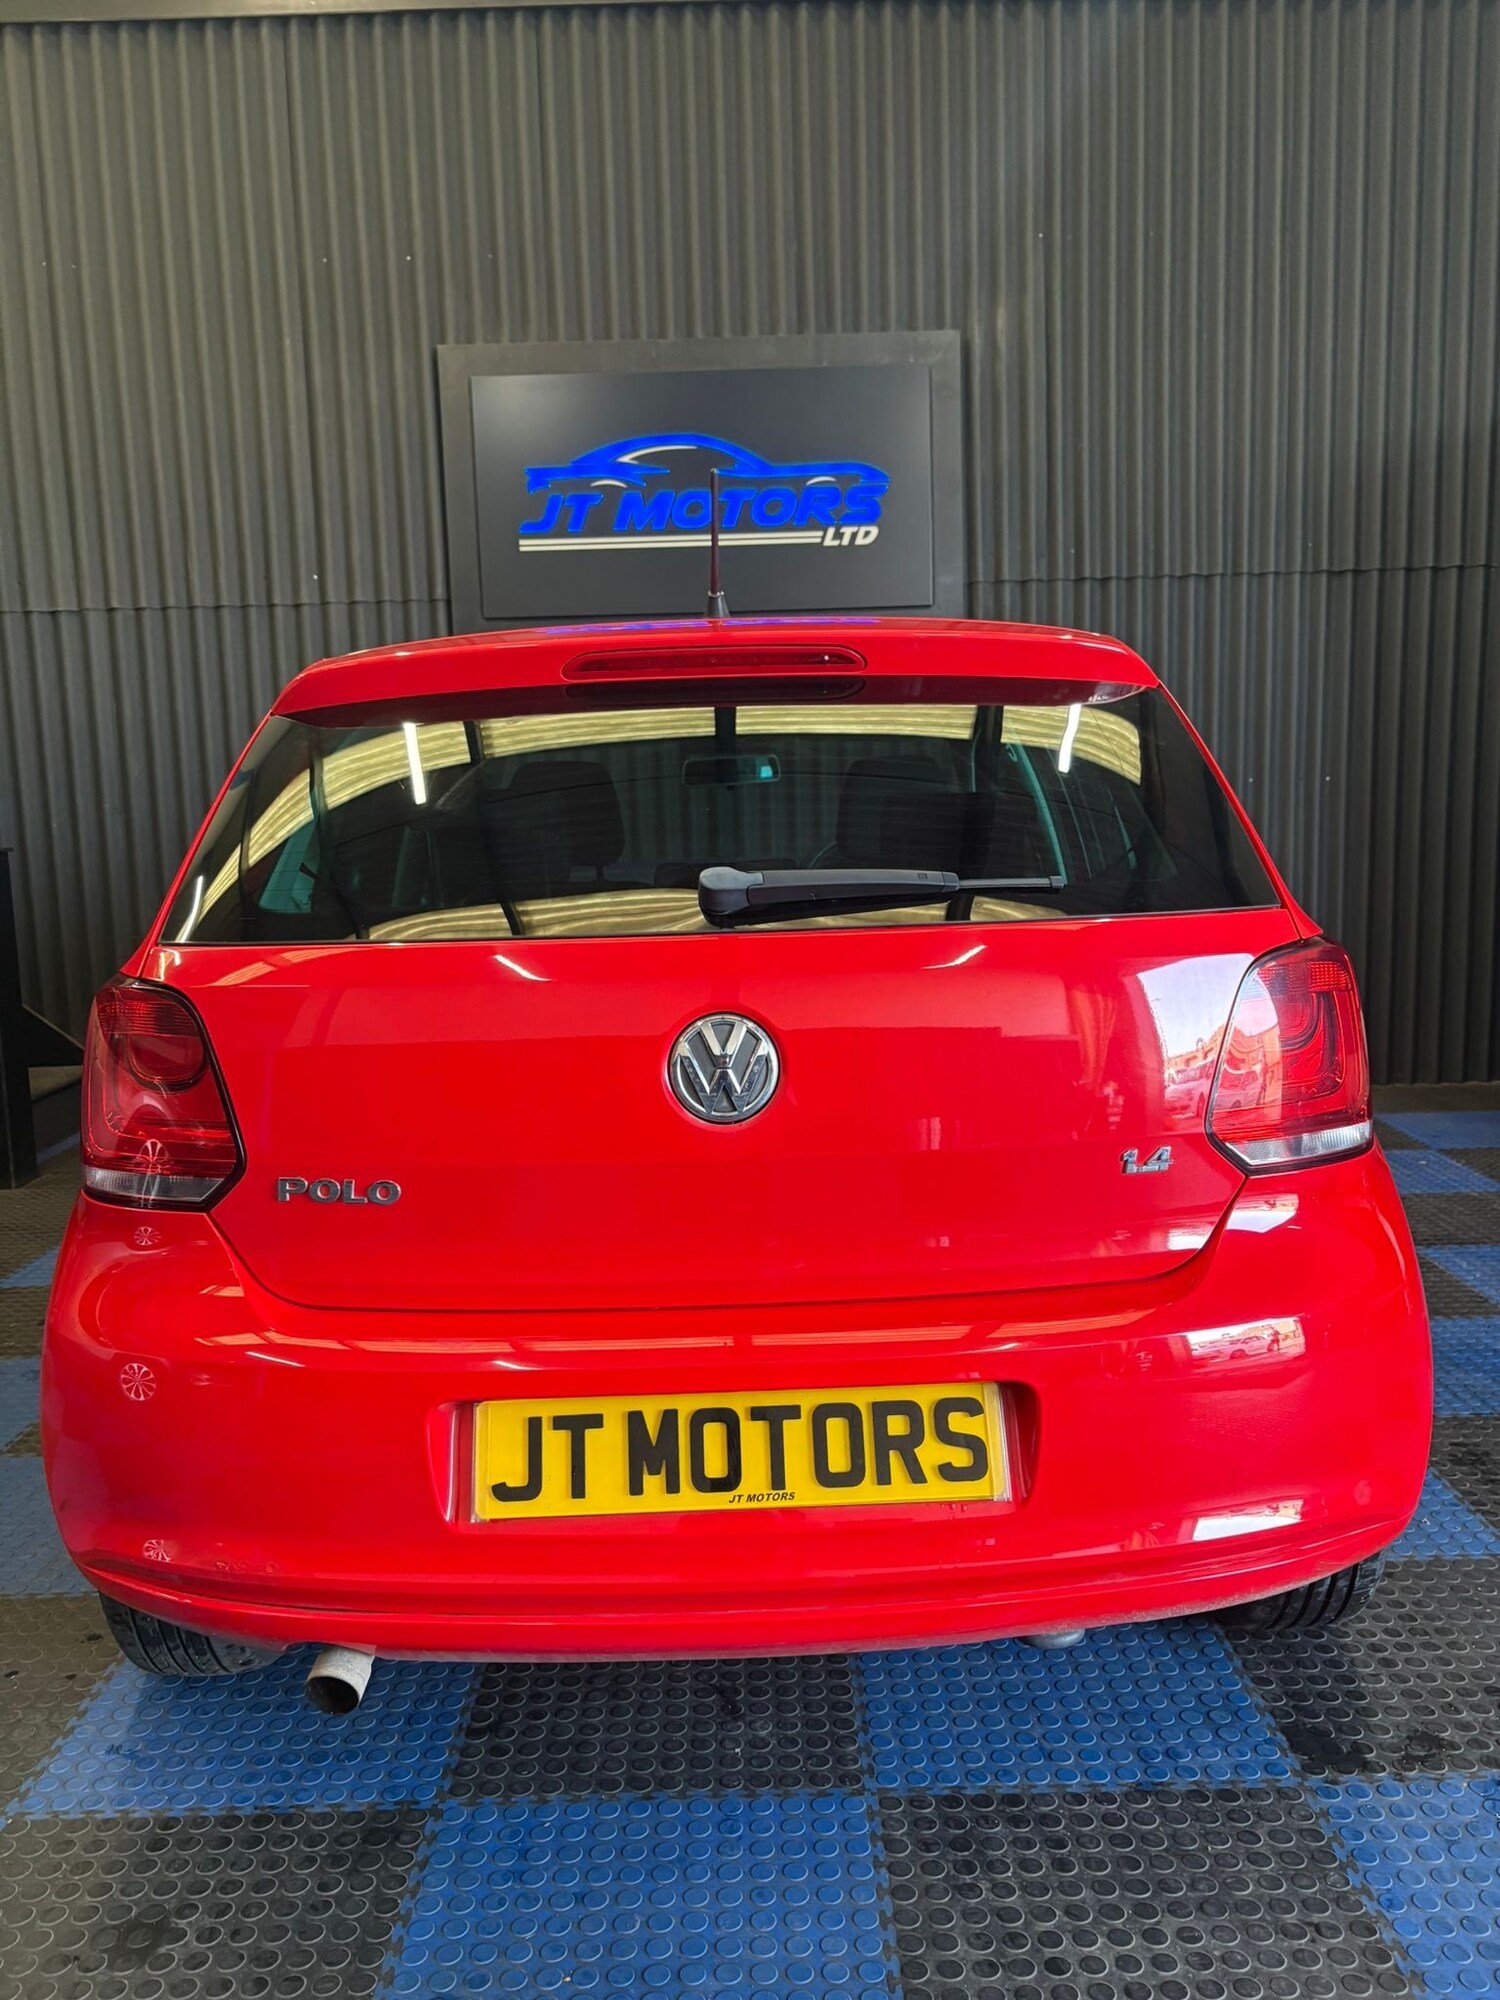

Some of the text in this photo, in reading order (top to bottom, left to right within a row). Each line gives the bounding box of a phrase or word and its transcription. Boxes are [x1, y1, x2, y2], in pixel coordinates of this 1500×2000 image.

[519, 484, 889, 534] JT MOTORS
[822, 525, 880, 547] LTD
[277, 1176, 402, 1205] POLO
[490, 1397, 989, 1503] JT MOTORS
[728, 1492, 796, 1503] JT MOTORS
